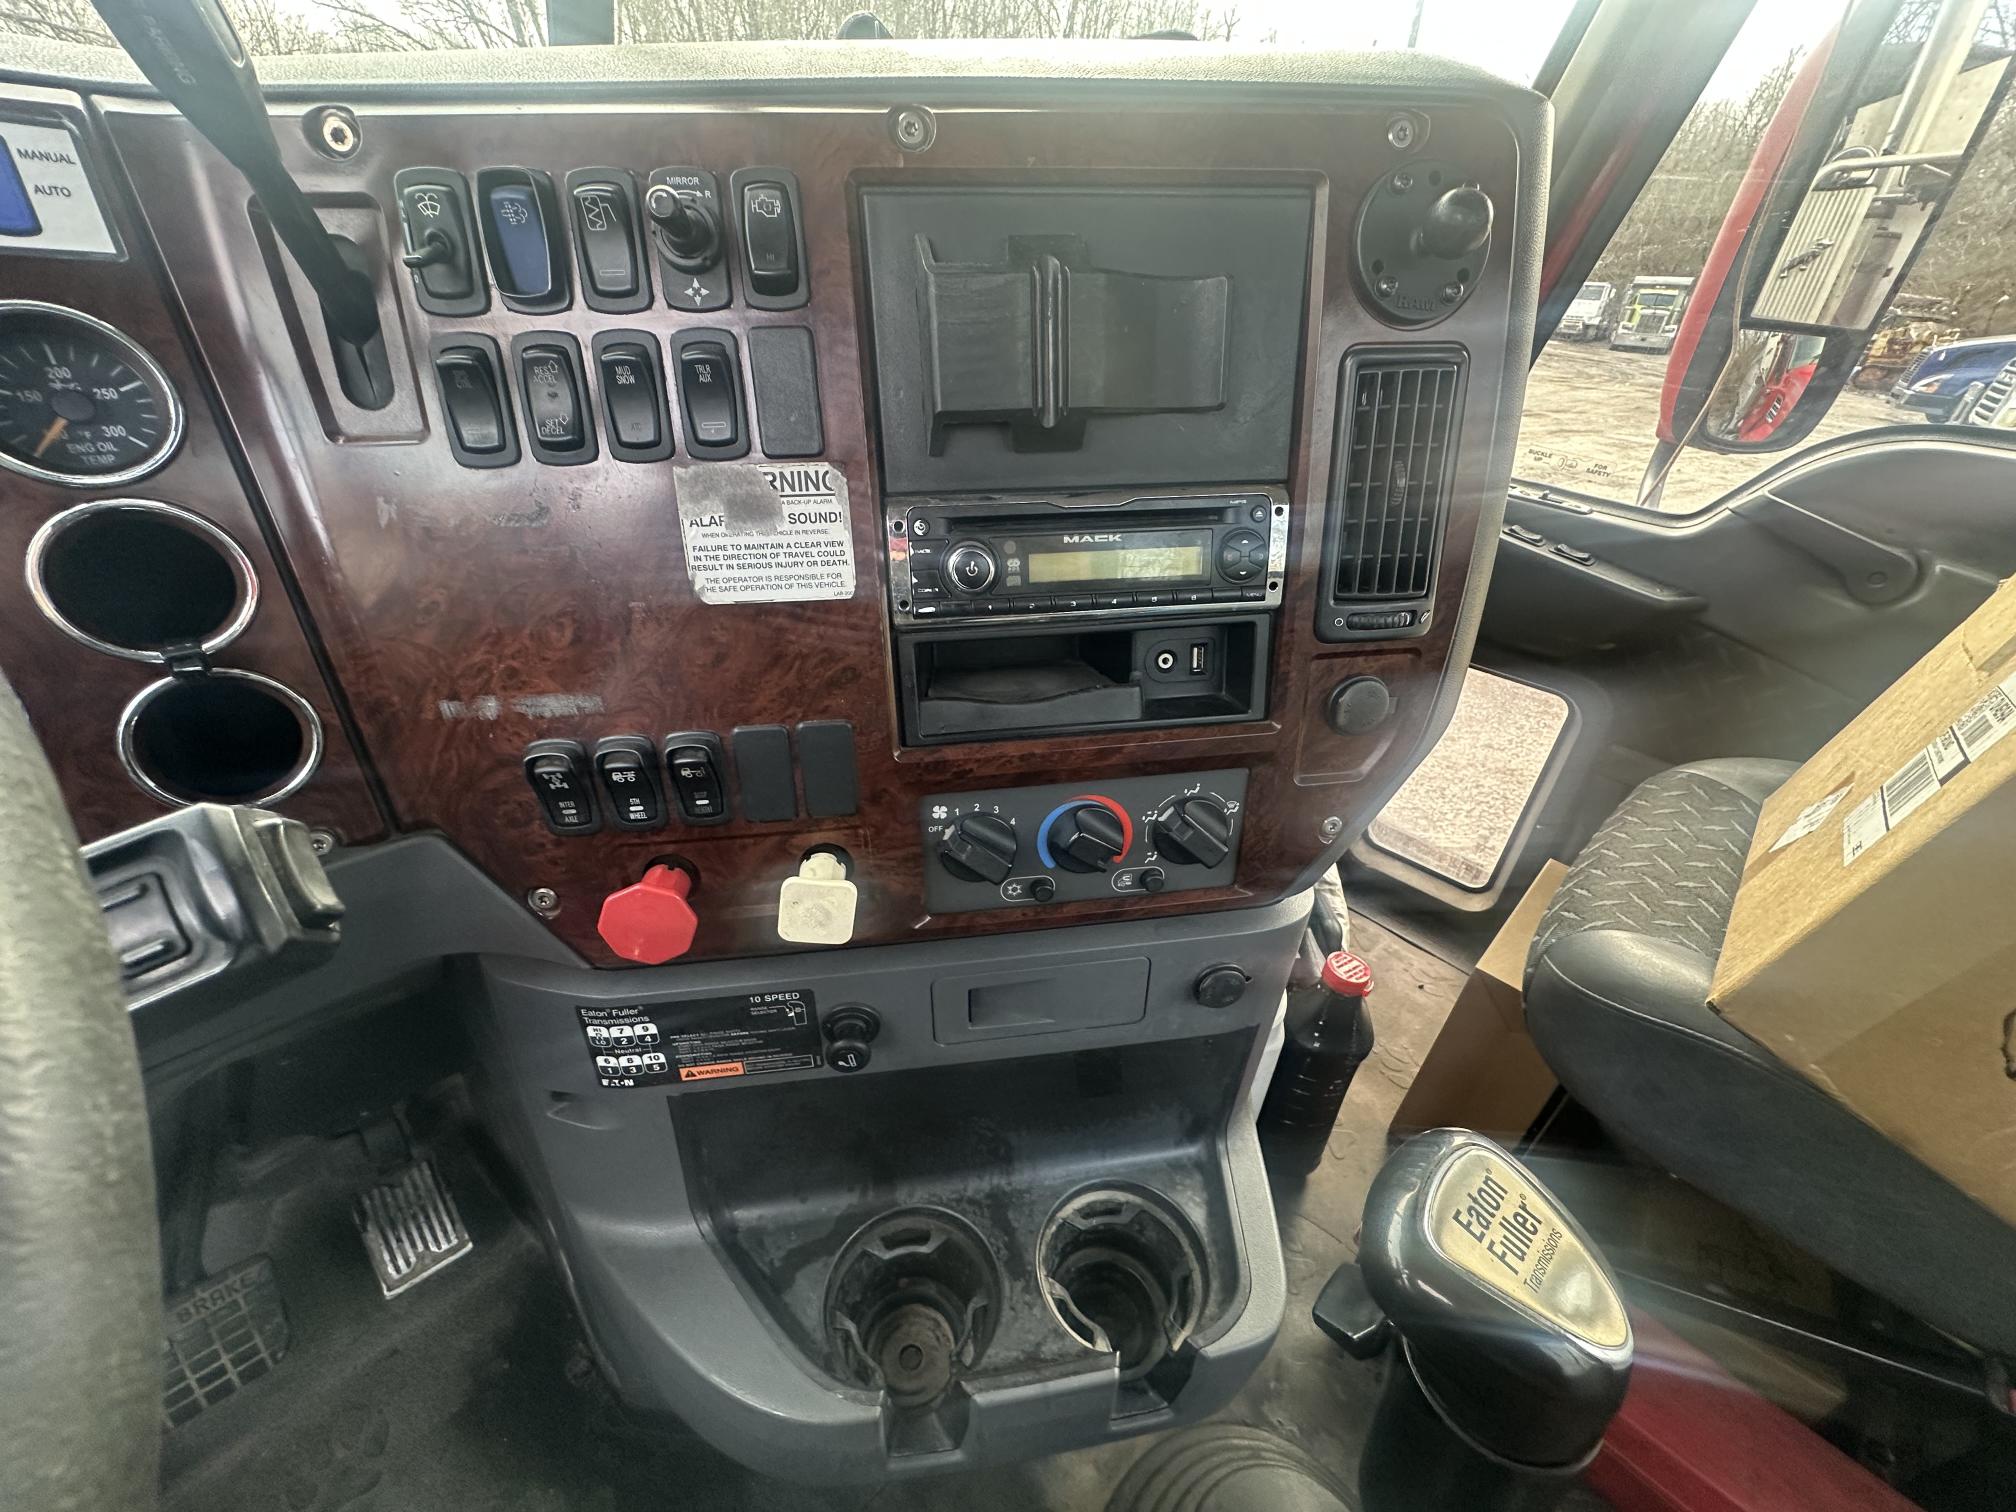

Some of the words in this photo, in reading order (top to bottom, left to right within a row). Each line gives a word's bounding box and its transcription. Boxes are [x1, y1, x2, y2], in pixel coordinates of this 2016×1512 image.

[16, 147, 77, 165] MANUAL
[666, 176, 700, 186] MIRROR
[34, 184, 71, 198] AUTO
[704, 190, 712, 198] R
[44, 366, 72, 379] 200
[533, 366, 551, 375] RES
[615, 365, 631, 375] MUD
[694, 364, 712, 374] TRLR
[616, 374, 636, 385] SNOW
[699, 373, 713, 383] AUX
[16, 389, 43, 402] 150
[92, 388, 119, 400] 250
[545, 419, 560, 428] SET
[101, 425, 127, 438] 300
[541, 426, 565, 435] DECEL
[66, 441, 96, 454] ENG
[96, 441, 119, 452] OIL
[1528, 448, 1553, 459] BUCKLE
[80, 453, 116, 466] TEMP
[1594, 463, 1608, 471] FOR
[1585, 467, 1611, 478] SAFETY
[788, 511, 842, 525] SOUND!
[1063, 534, 1122, 544] MACK
[794, 541, 821, 549] CLEAR
[823, 540, 844, 548] VIEW
[723, 552, 768, 561] DIRECTION
[783, 550, 815, 558] TRAVEL
[691, 563, 723, 572] RESULT
[736, 562, 773, 570] SERIOUS
[774, 560, 804, 569] INJURY
[722, 575, 763, 584] OPERATOR
[774, 573, 825, 582] RESPONSIBLE
[719, 585, 738, 593] SAFE
[739, 584, 783, 592] OPERATION
[954, 807, 960, 816] 1
[973, 803, 980, 811] 2
[993, 805, 999, 814] 3
[565, 815, 578, 823] AXLE
[629, 812, 647, 820] WHEEL
[1010, 817, 1016, 825] 4
[928, 825, 943, 833] OFF
[764, 992, 800, 1002] SPEED
[582, 1016, 650, 1025] Transmissions
[696, 1066, 739, 1077] WARNING
[1523, 1228, 1562, 1294] Transmissions
[176, 1270, 257, 1323] BRAKE
